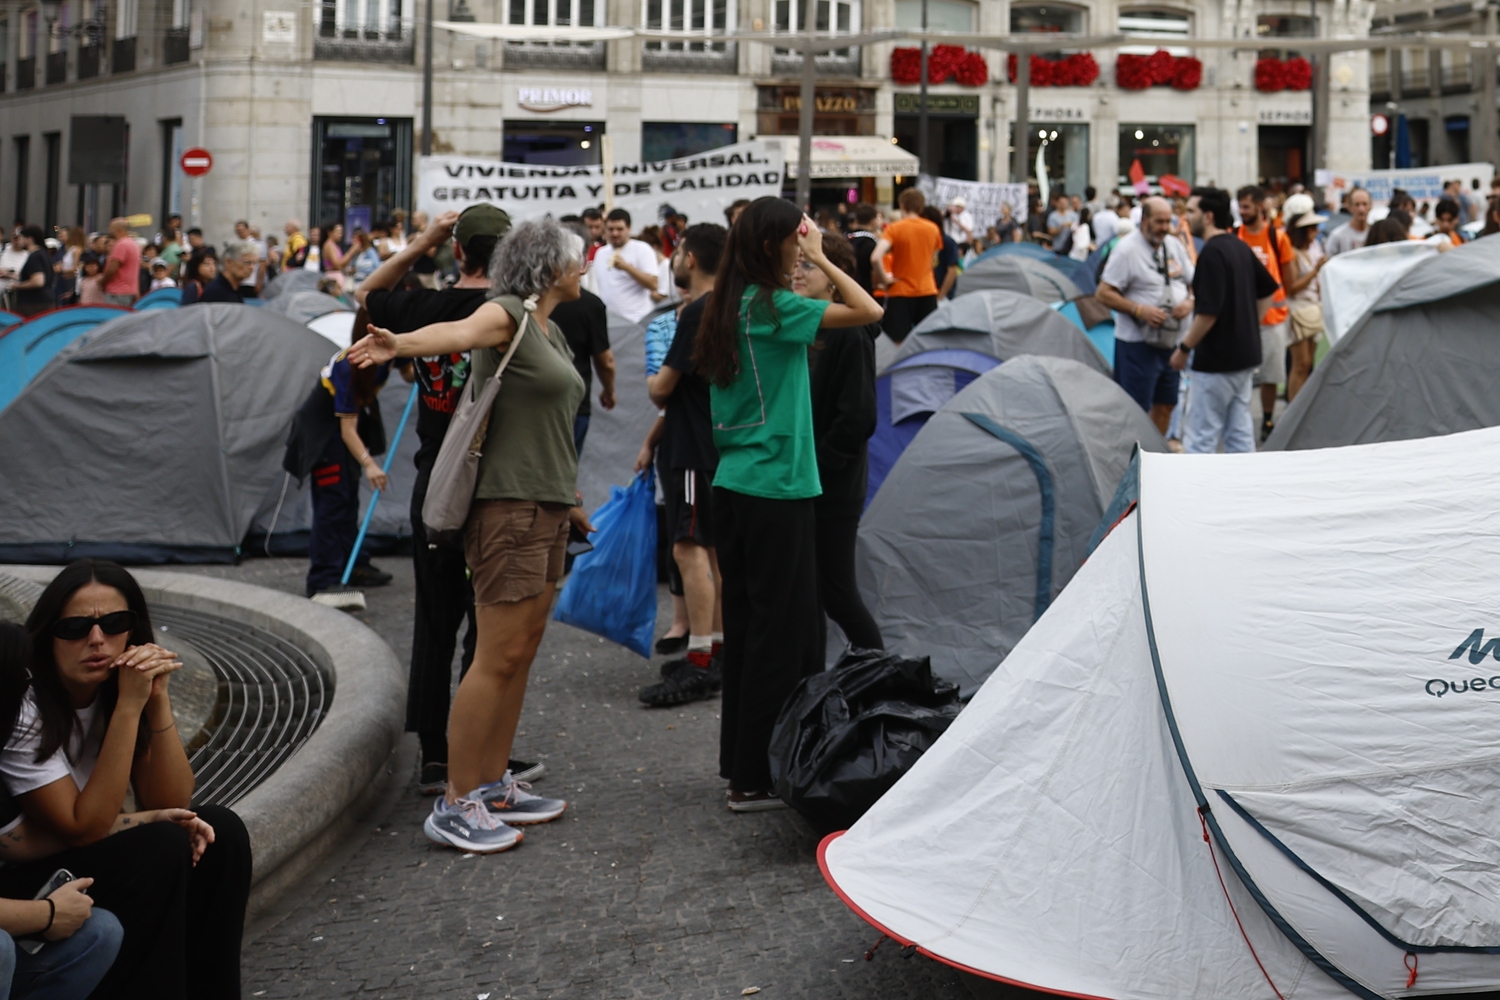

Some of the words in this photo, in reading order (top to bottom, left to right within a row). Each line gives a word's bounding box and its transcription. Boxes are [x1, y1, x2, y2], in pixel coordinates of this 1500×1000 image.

[518, 87, 592, 105] PRIMOR
[783, 95, 857, 111] PAAZZO
[444, 164, 592, 179] VIVIENDA
[432, 185, 578, 202] GRATUITA
[585, 184, 606, 199] Y
[613, 181, 652, 198] DE
[660, 171, 780, 194] CALIDAD
